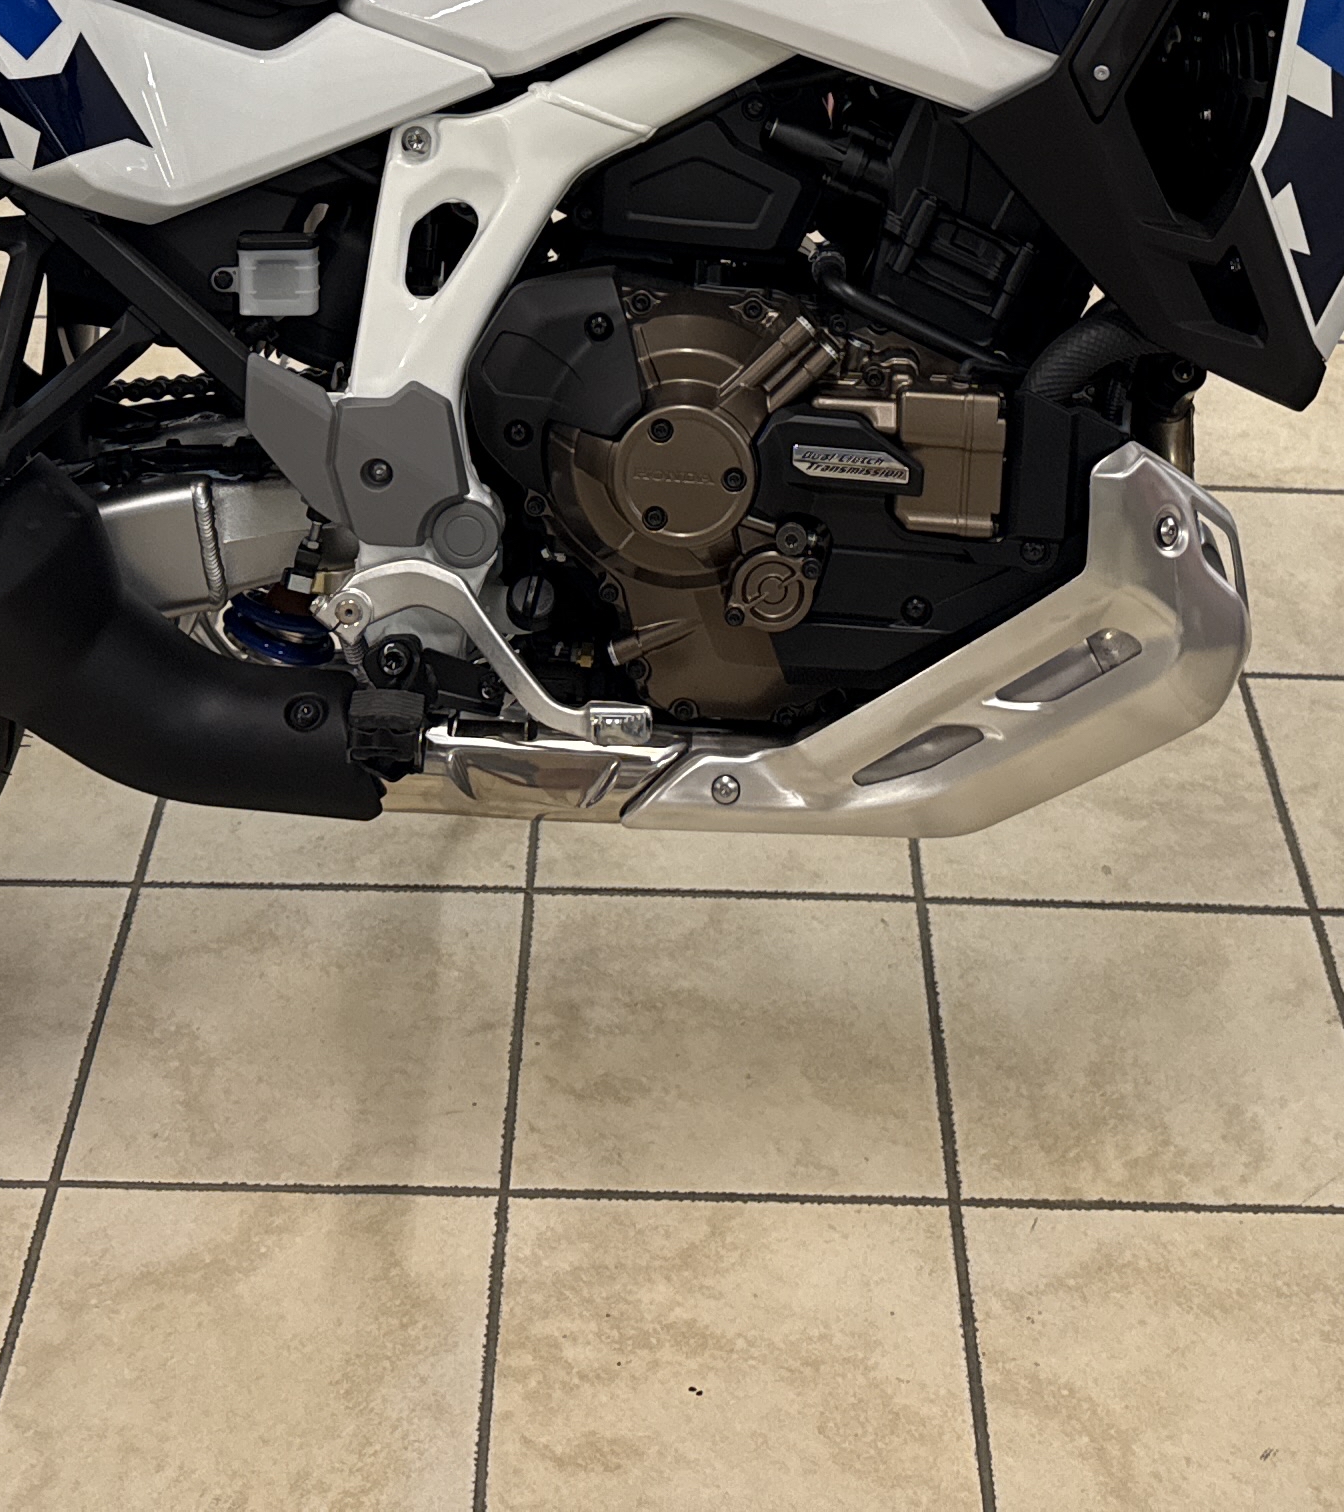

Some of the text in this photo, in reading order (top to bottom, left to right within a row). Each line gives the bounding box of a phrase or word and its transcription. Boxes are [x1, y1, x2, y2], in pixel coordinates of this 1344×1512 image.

[801, 450, 885, 466] Dual Clutch
[632, 468, 716, 486] HONDA
[806, 462, 906, 479] Transmission
